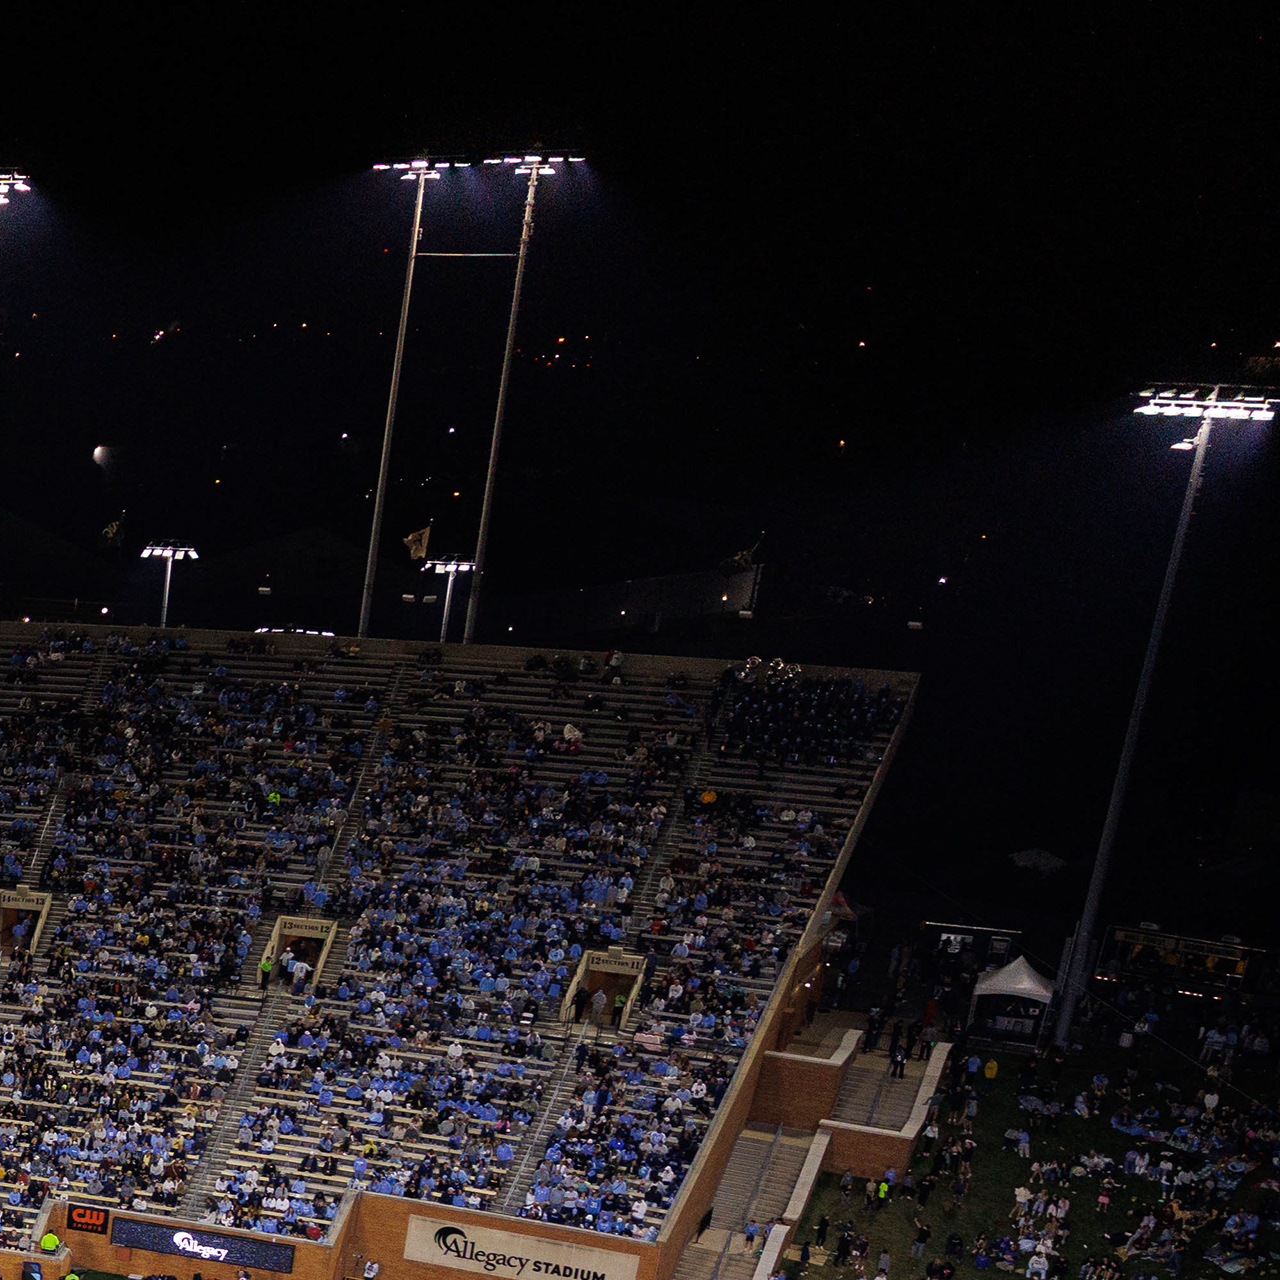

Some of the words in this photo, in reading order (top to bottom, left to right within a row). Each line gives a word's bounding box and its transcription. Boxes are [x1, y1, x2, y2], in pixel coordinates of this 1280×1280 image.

[71, 1208, 105, 1226] CW
[72, 1222, 102, 1232] SPORTS
[178, 1236, 230, 1262] Allegacy
[443, 1231, 531, 1276] Allegacy
